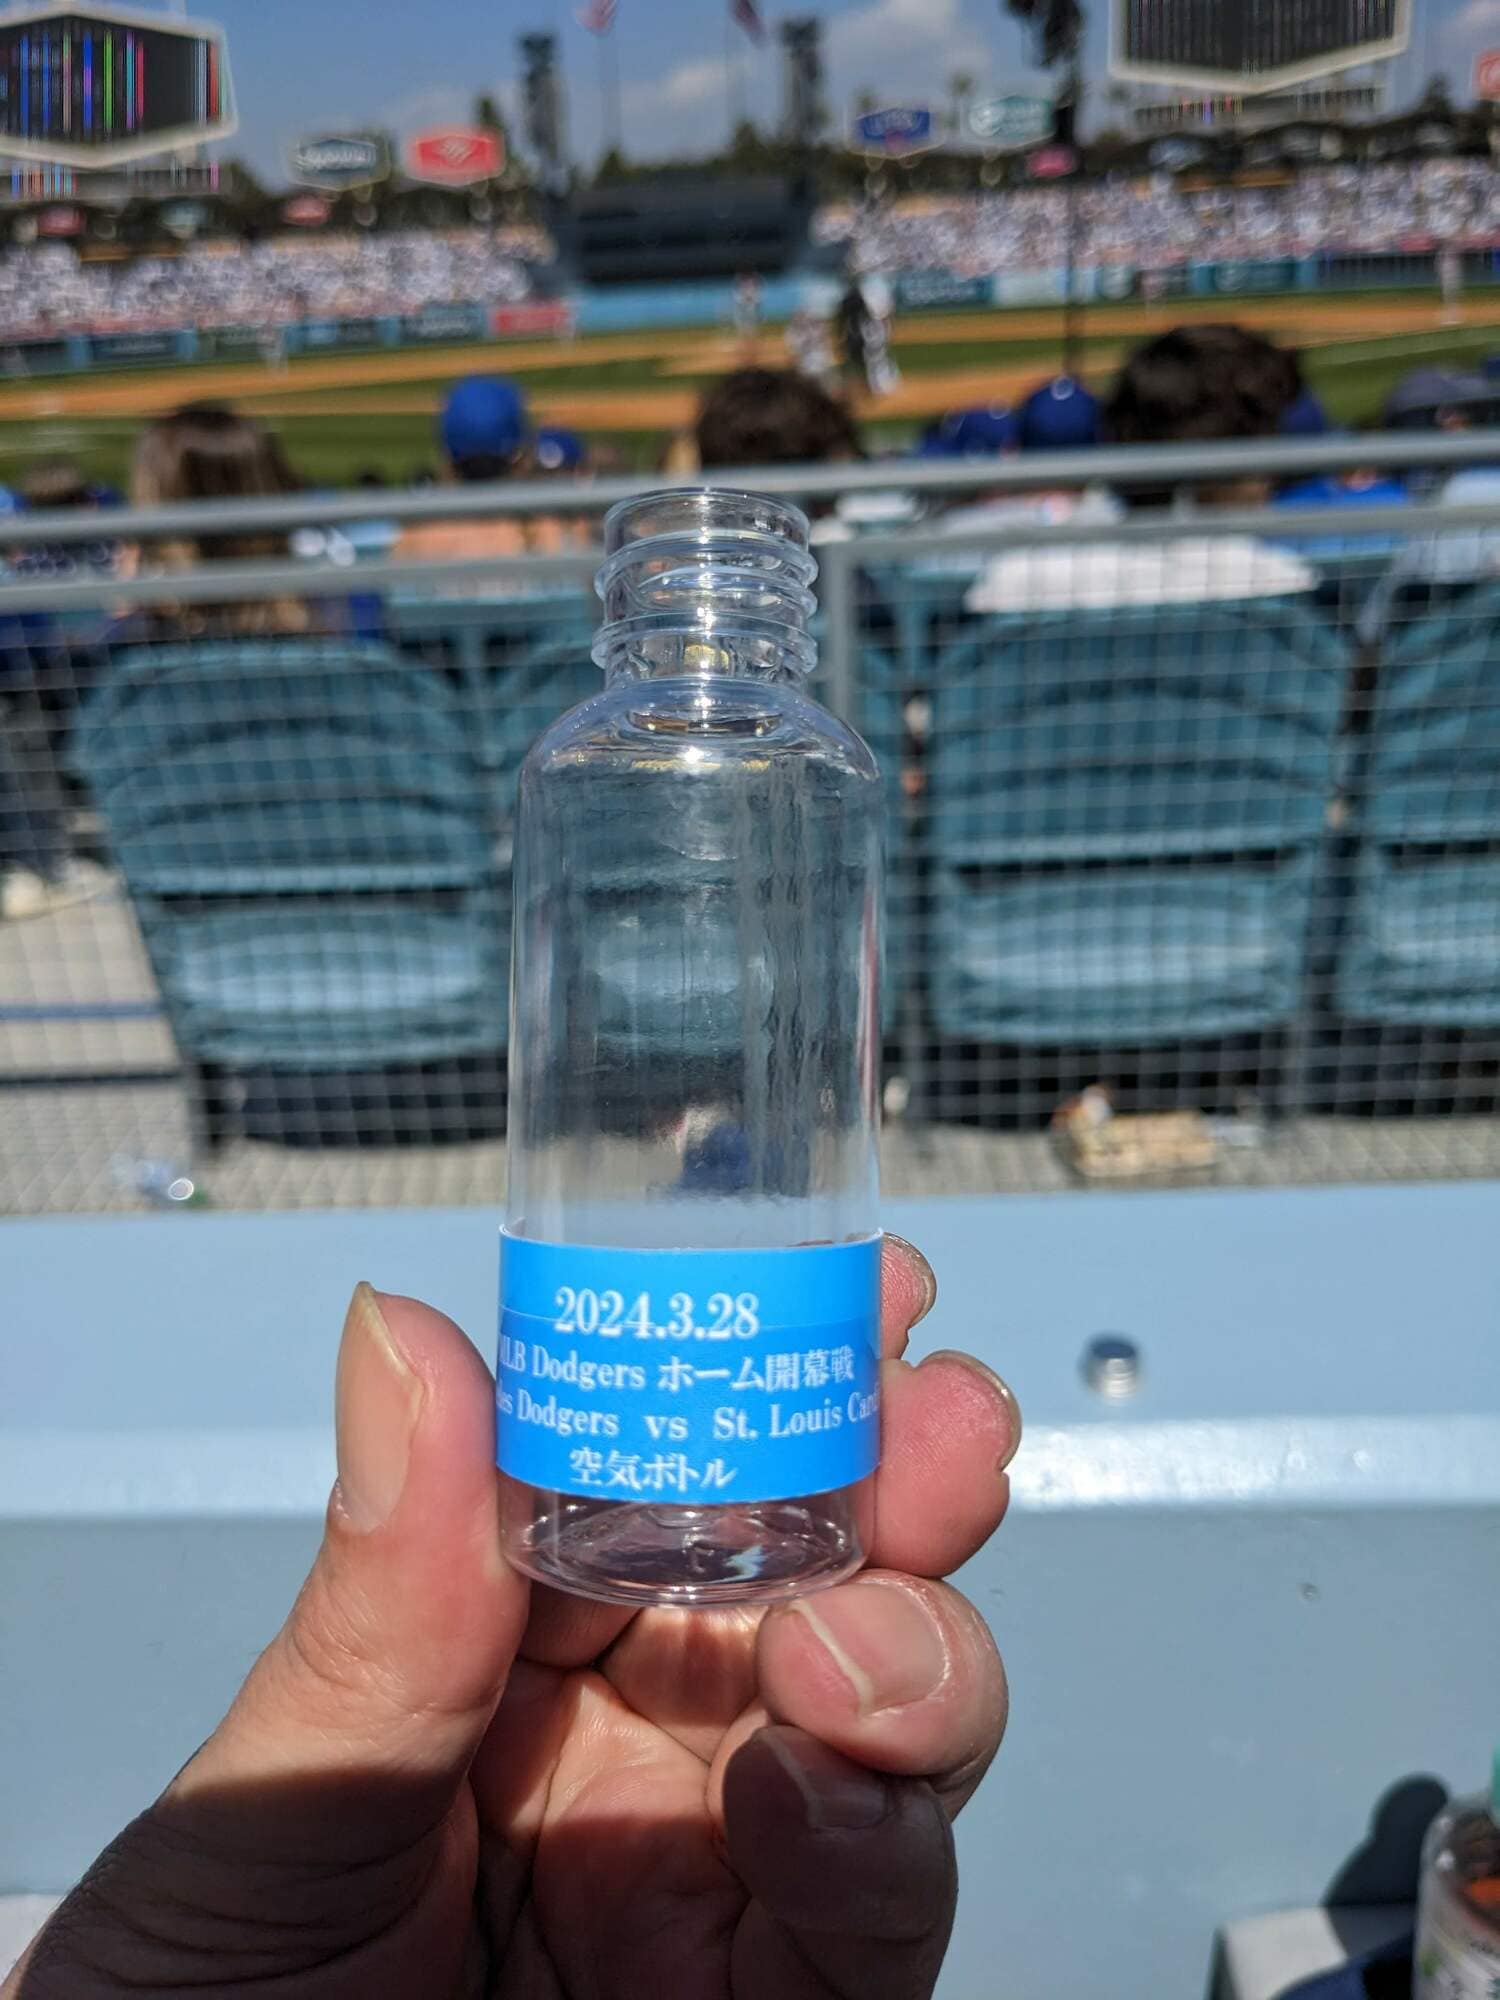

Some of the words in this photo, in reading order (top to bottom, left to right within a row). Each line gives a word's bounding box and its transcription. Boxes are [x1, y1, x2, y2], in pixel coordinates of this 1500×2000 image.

[554, 1287, 759, 1339] 2024.3.28
[532, 1344, 646, 1391] Dodgers
[659, 1345, 854, 1392] ホーム開幕戦
[518, 1388, 619, 1436] Dodgers
[644, 1414, 688, 1440] vs
[713, 1406, 757, 1439] St.
[769, 1397, 842, 1438] Louis
[569, 1446, 737, 1491] 空気ボトル
